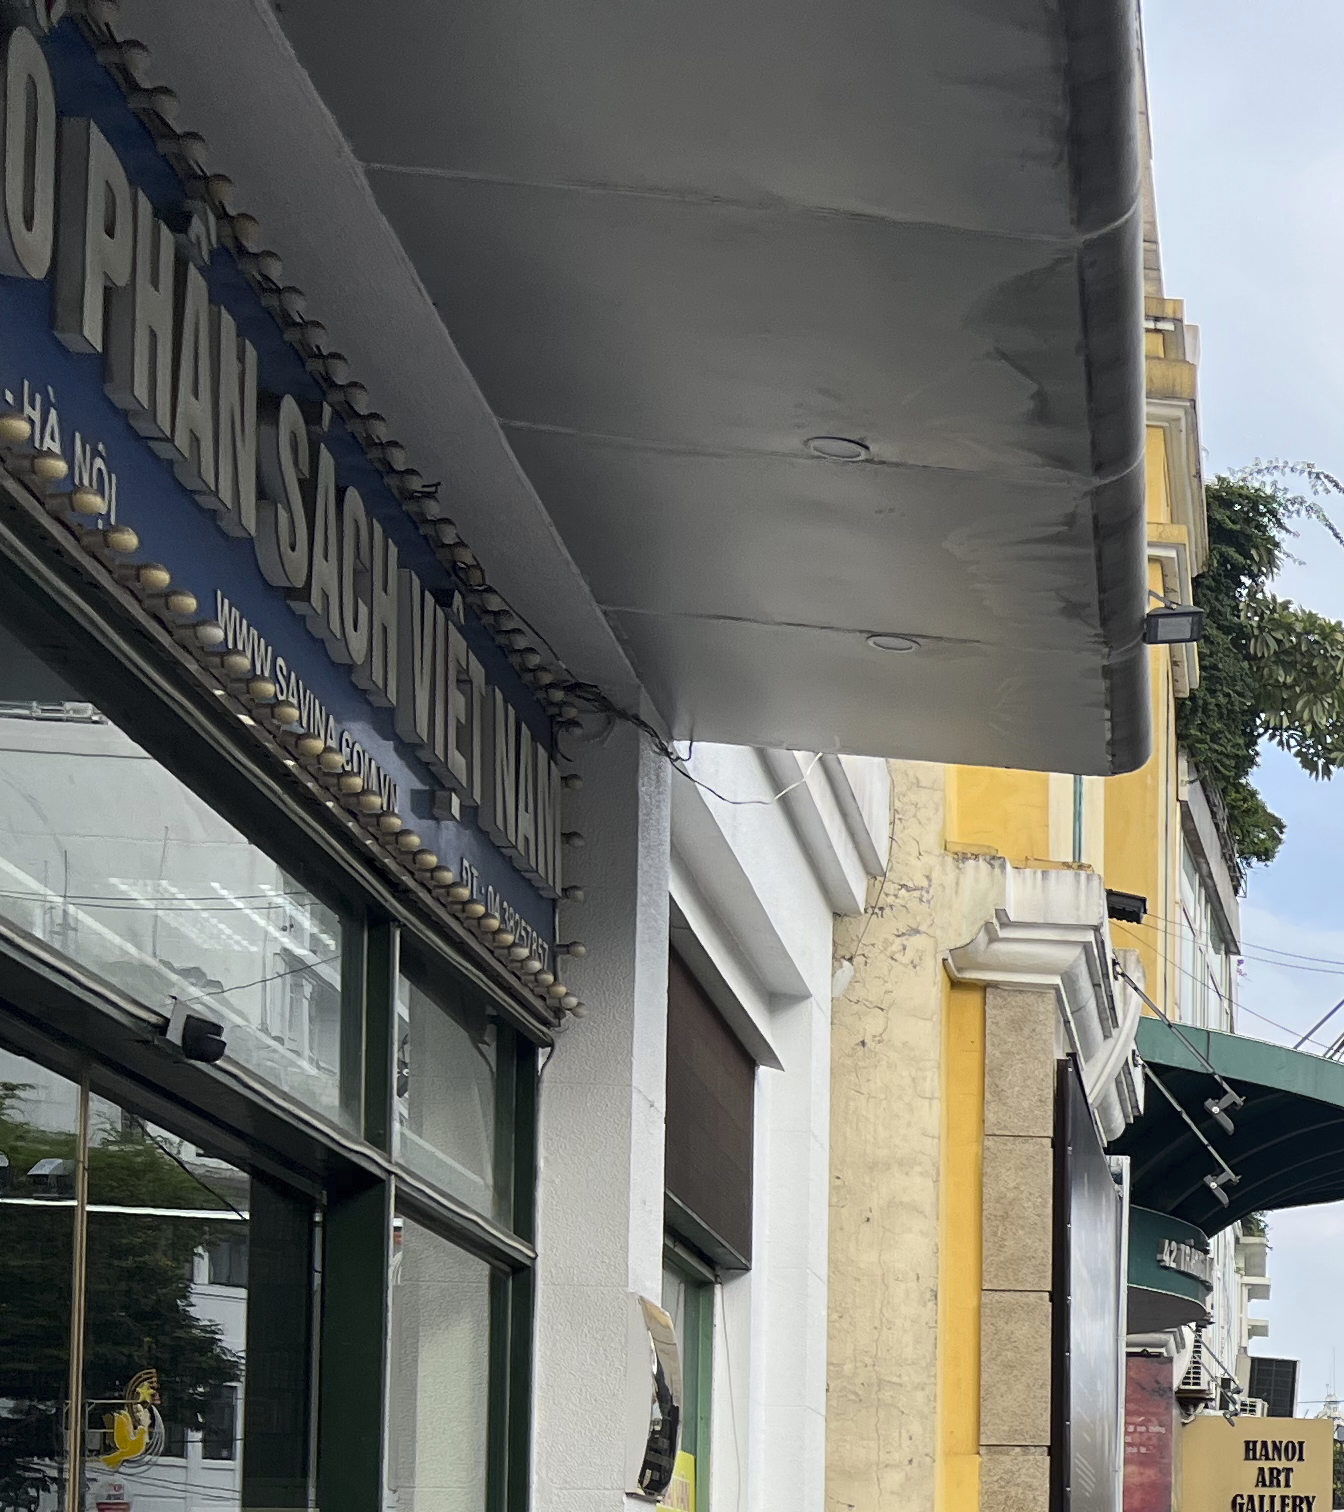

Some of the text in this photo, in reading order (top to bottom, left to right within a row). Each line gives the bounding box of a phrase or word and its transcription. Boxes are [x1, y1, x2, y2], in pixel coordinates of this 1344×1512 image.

[23, 378, 117, 529] HÀ NỘI
[258, 393, 398, 708] SÁCH
[397, 566, 486, 822] VIỆT
[479, 685, 562, 899] NAM
[1243, 1439, 1306, 1462] HANOI
[1254, 1466, 1294, 1488] ART
